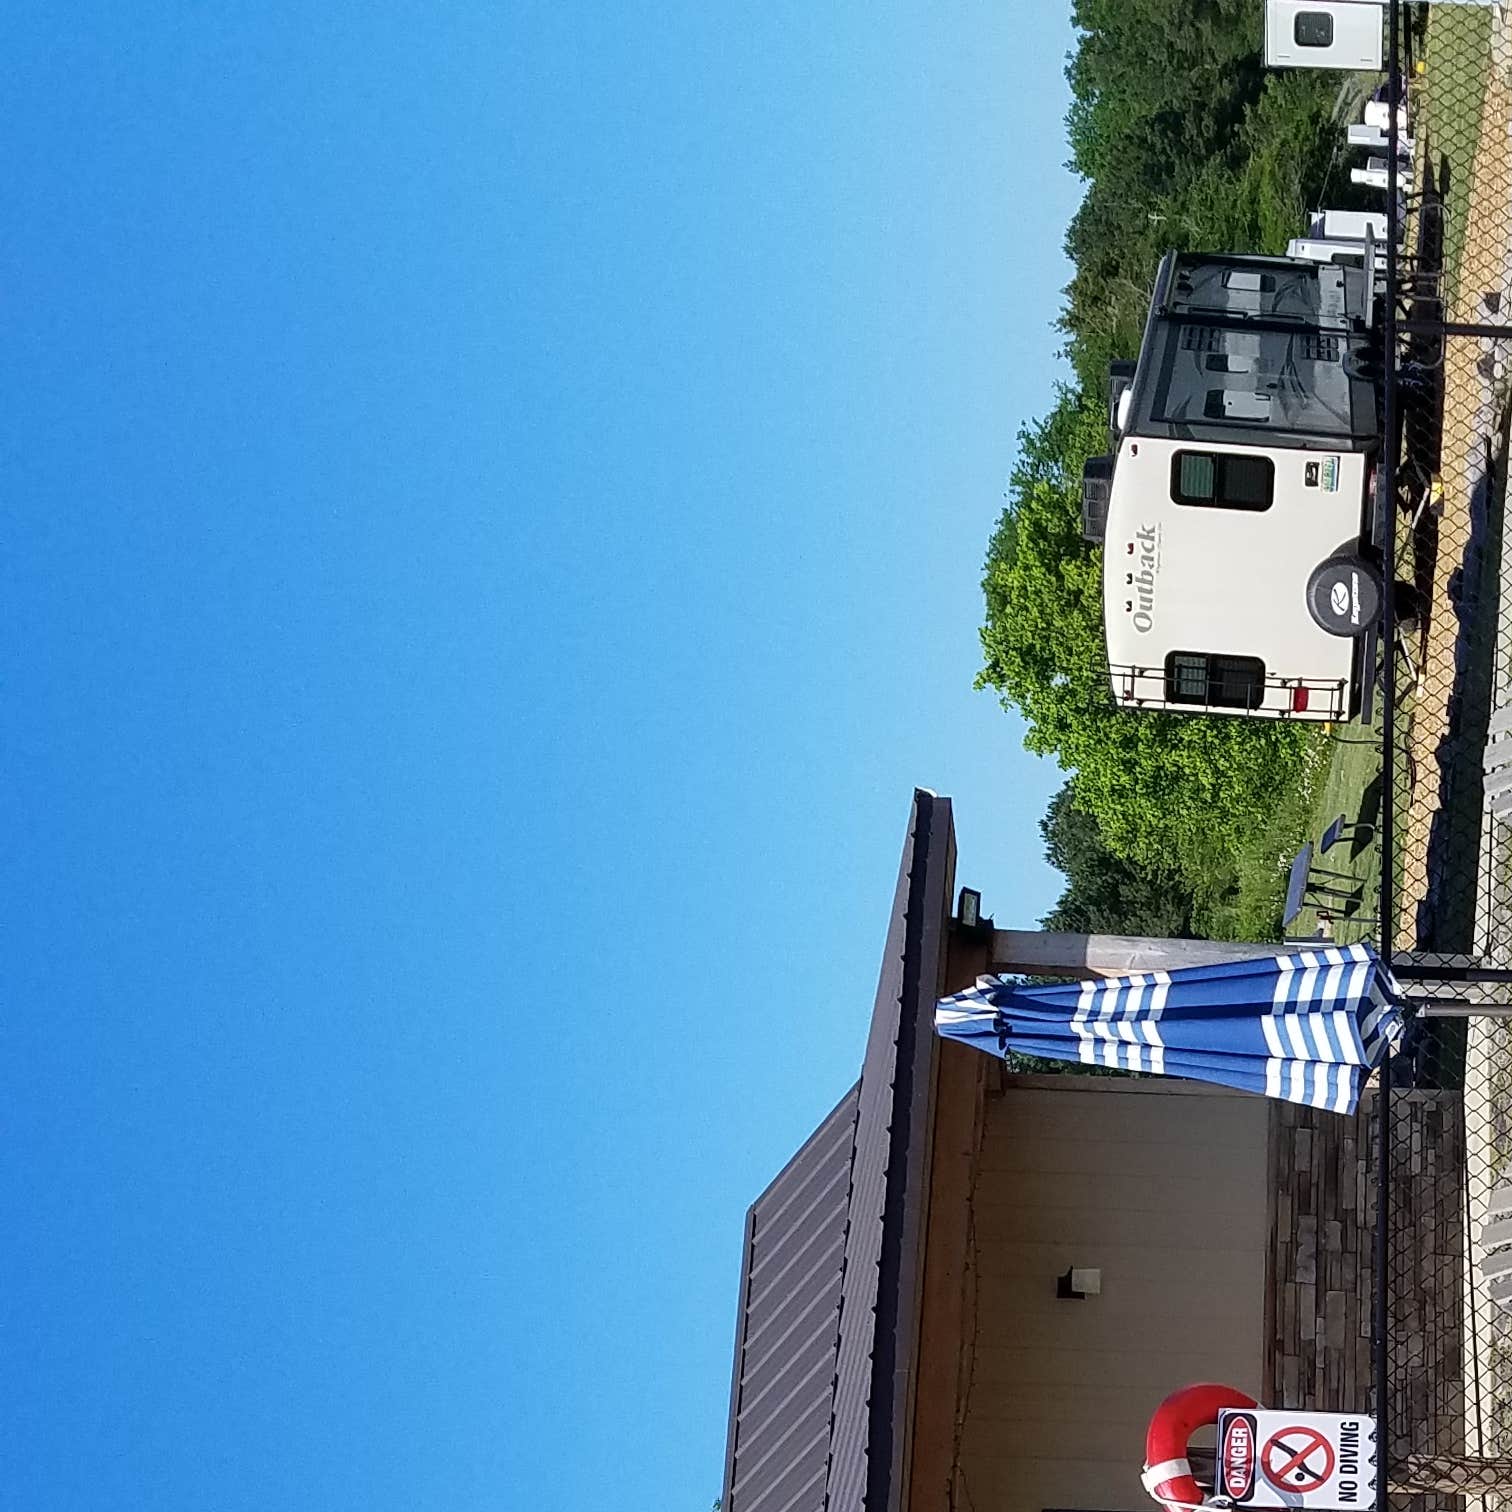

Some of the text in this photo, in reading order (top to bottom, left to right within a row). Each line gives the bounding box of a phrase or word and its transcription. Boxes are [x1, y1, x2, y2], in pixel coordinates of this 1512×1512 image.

[1133, 524, 1156, 633] Outback
[1230, 1427, 1248, 1488] DANGER
[1338, 1421, 1359, 1502] NO DIVING
